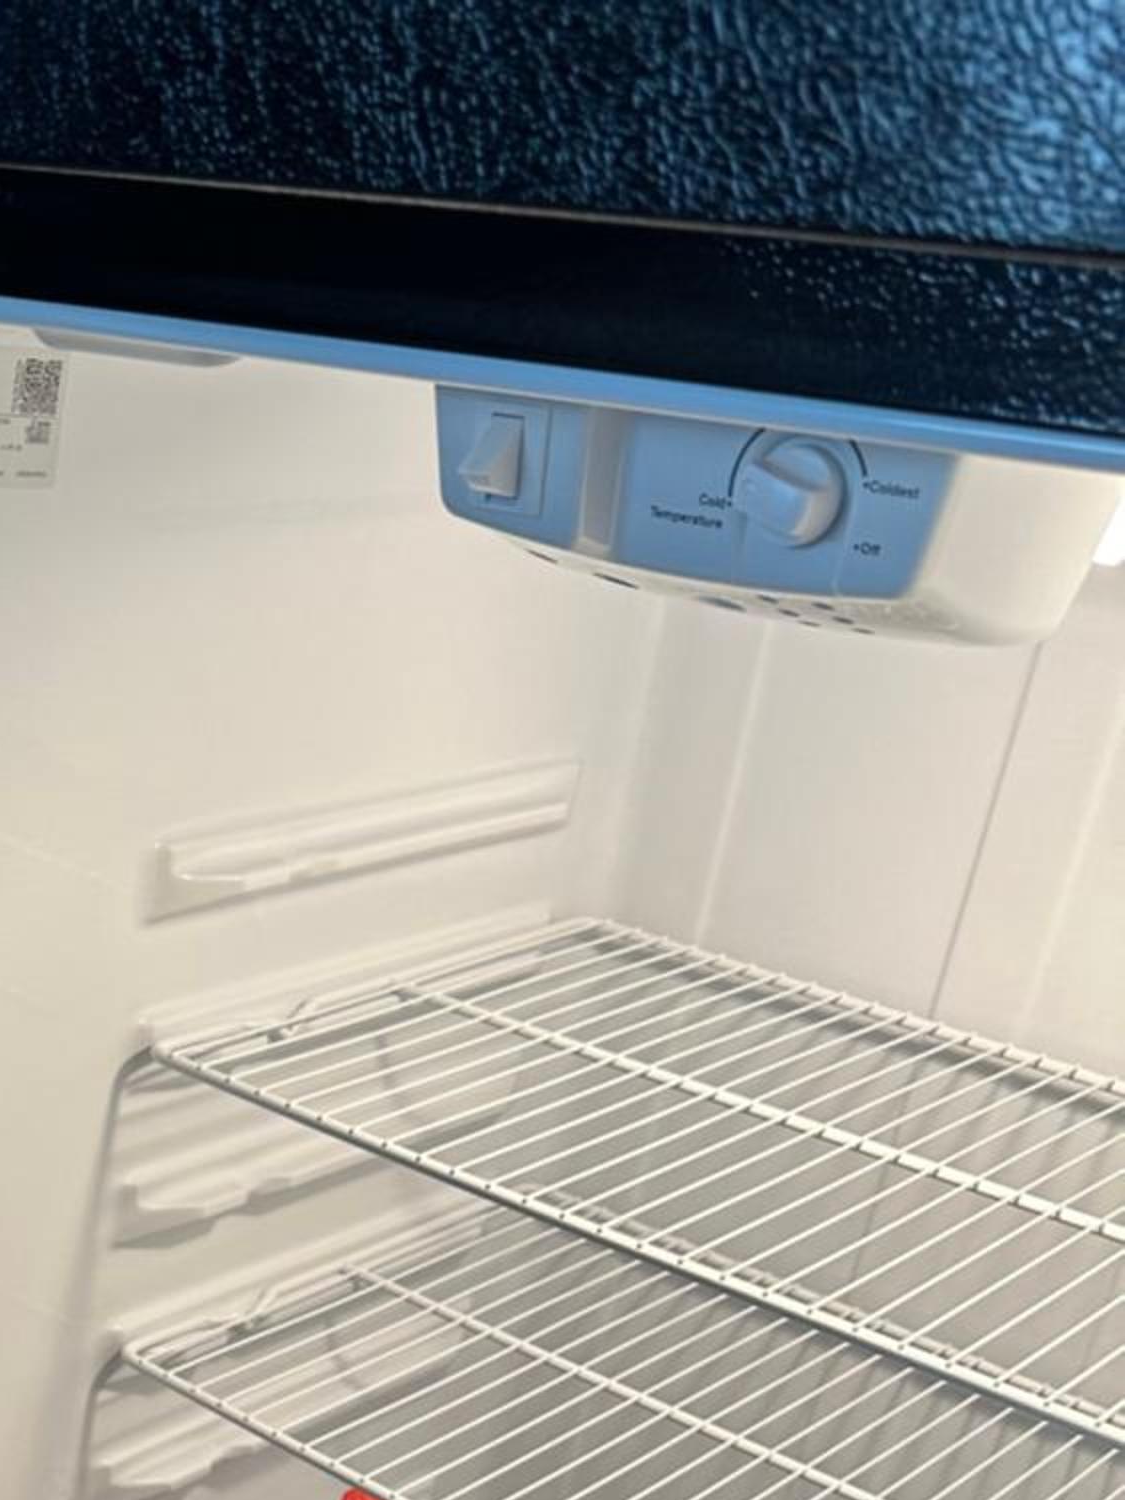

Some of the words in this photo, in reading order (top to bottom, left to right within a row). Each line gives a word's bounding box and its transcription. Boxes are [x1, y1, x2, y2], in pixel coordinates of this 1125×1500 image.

[869, 480, 921, 499] Coldest
[698, 492, 725, 509] Cold
[651, 506, 723, 527] Temperature
[860, 542, 881, 555] Off
